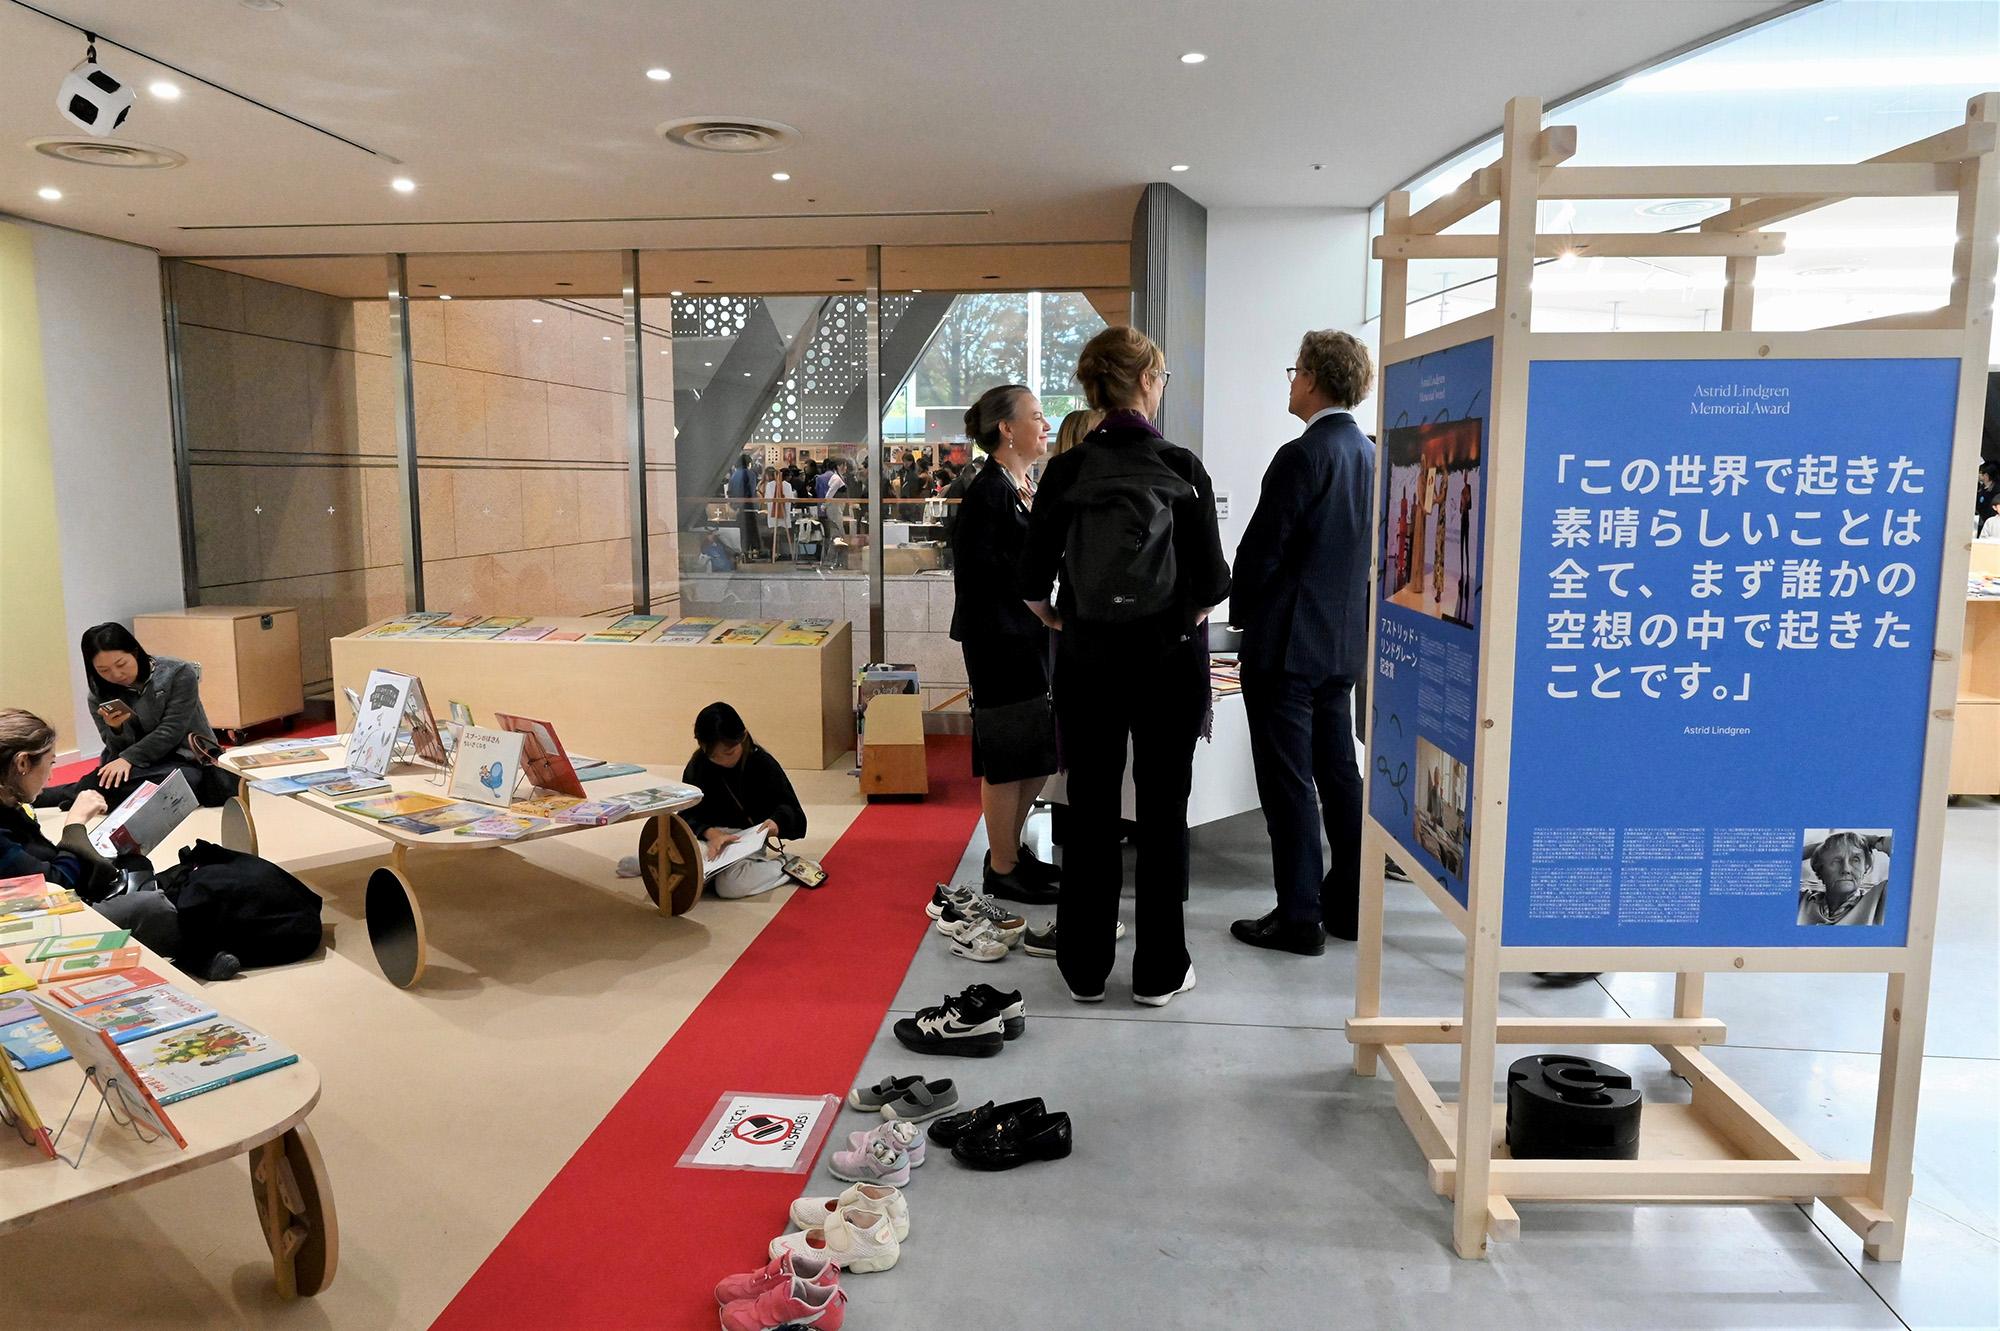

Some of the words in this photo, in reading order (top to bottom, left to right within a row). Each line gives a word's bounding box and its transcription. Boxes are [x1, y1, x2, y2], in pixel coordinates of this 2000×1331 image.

[1690, 402, 1750, 415] Memorial
[1751, 402, 1791, 415] Award
[1693, 384, 1731, 397] Astrid
[1733, 384, 1790, 400] Lindgren
[1557, 454, 1925, 497] 「この世界で起きた
[1551, 507, 1922, 549] 素晴らしいことは
[1548, 558, 1916, 600] 全て、まず誰かの
[1545, 610, 1911, 651] 空想の中で起きた
[1380, 638, 1418, 668] リンドグレーン
[1547, 662, 1751, 701] ことです。」
[1683, 726, 1710, 735] Astrid
[1711, 726, 1751, 737] Lindgren
